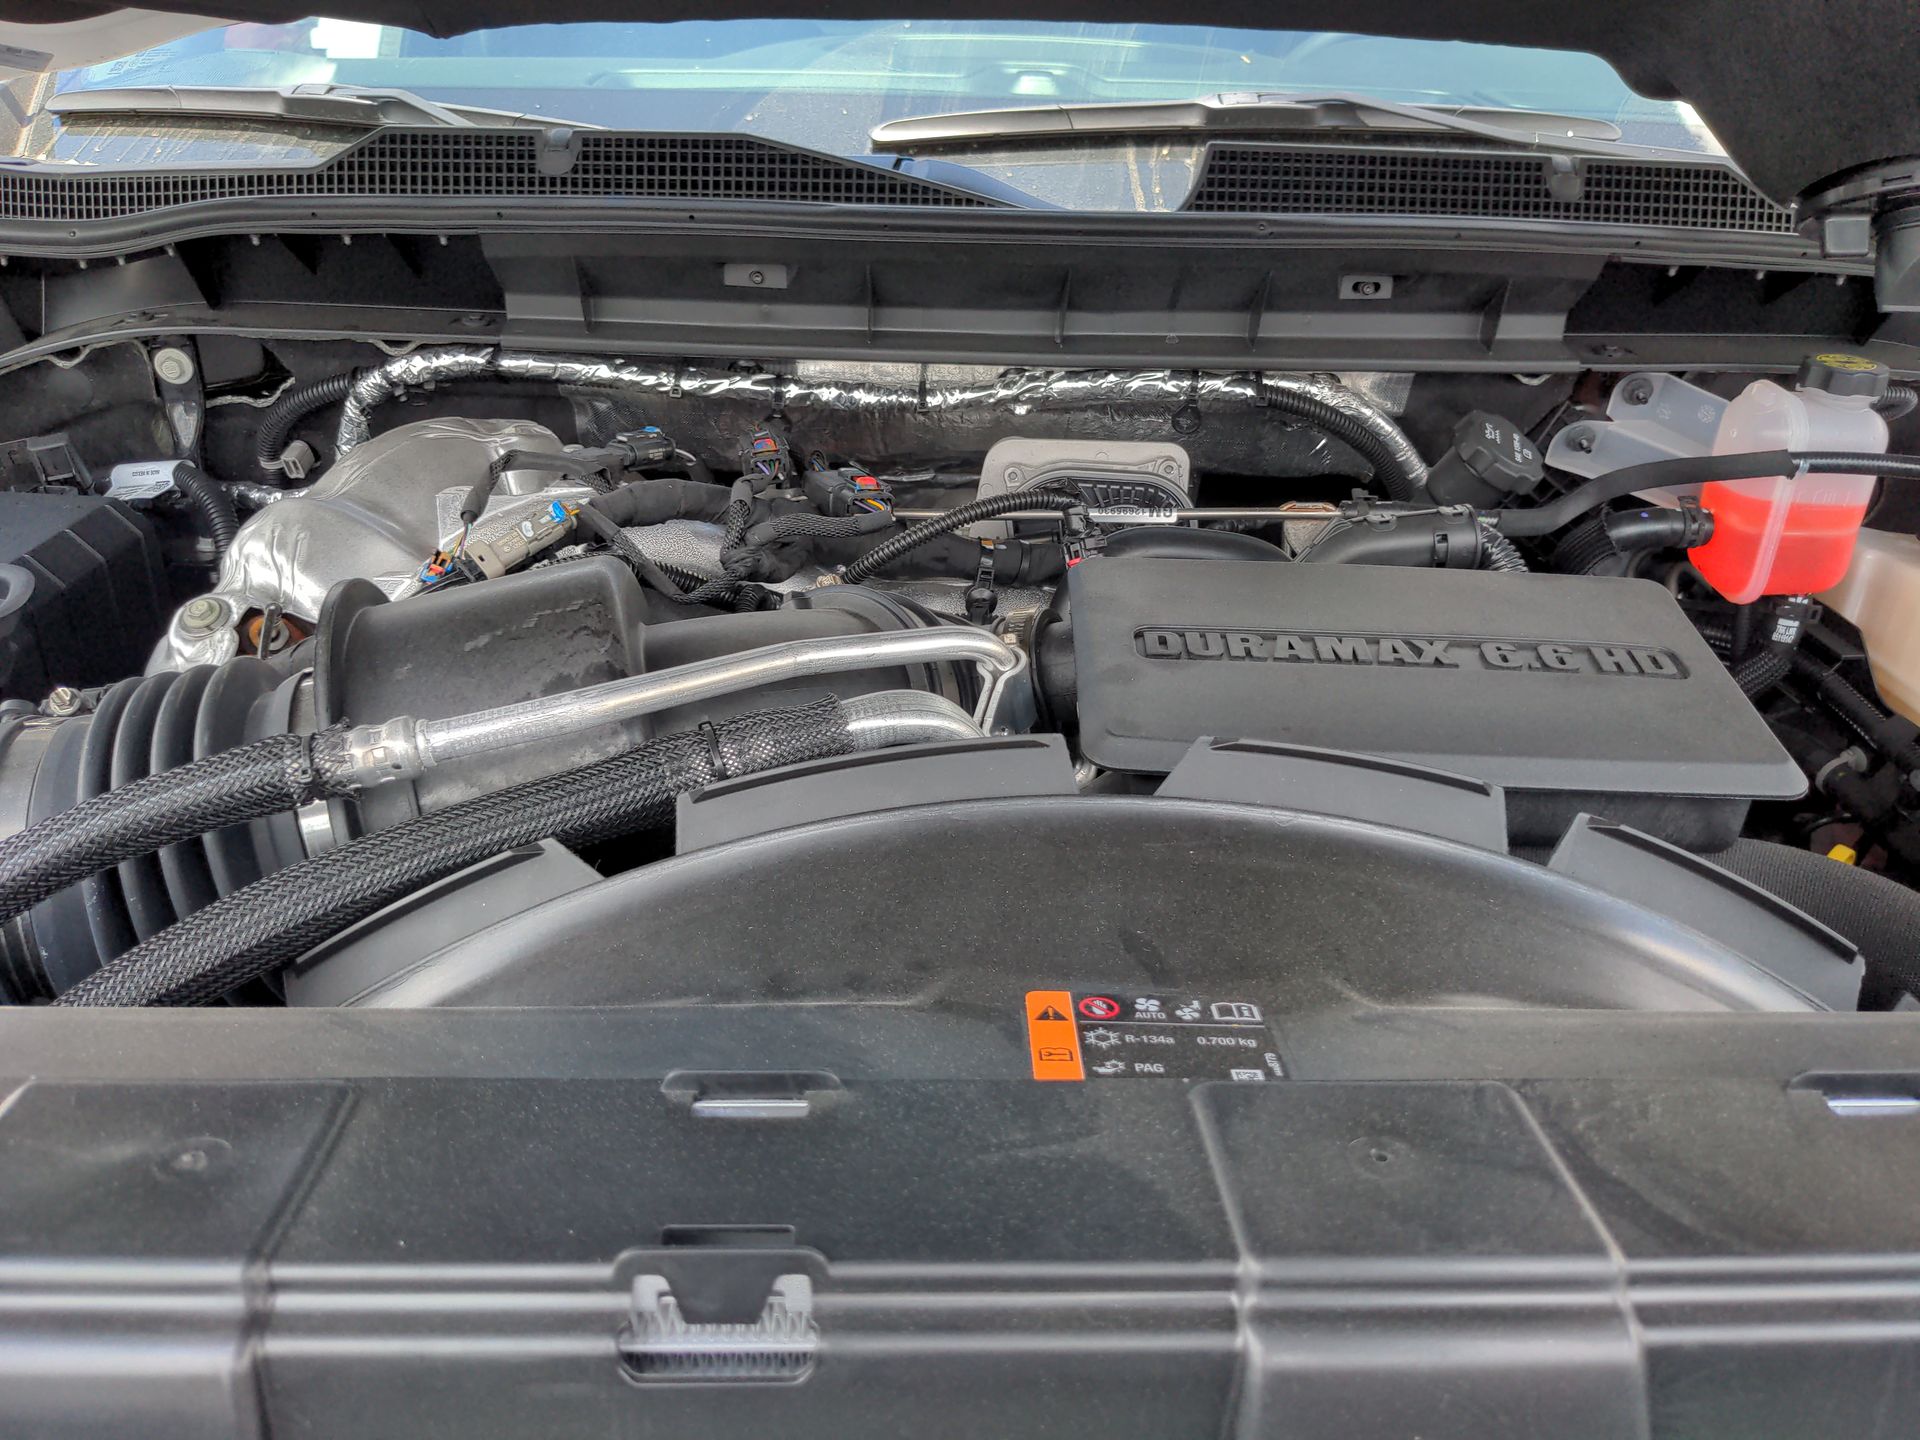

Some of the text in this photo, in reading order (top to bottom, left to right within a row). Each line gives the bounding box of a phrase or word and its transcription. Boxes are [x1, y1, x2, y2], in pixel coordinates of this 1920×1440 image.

[1148, 507, 1173, 518] GM
[1143, 631, 1687, 679] DURAMAX 6.6 HD
[1134, 1011, 1167, 1019] AUTO
[1124, 1034, 1258, 1048] R-134a 0.700 kg
[1134, 1063, 1165, 1073] PAG
